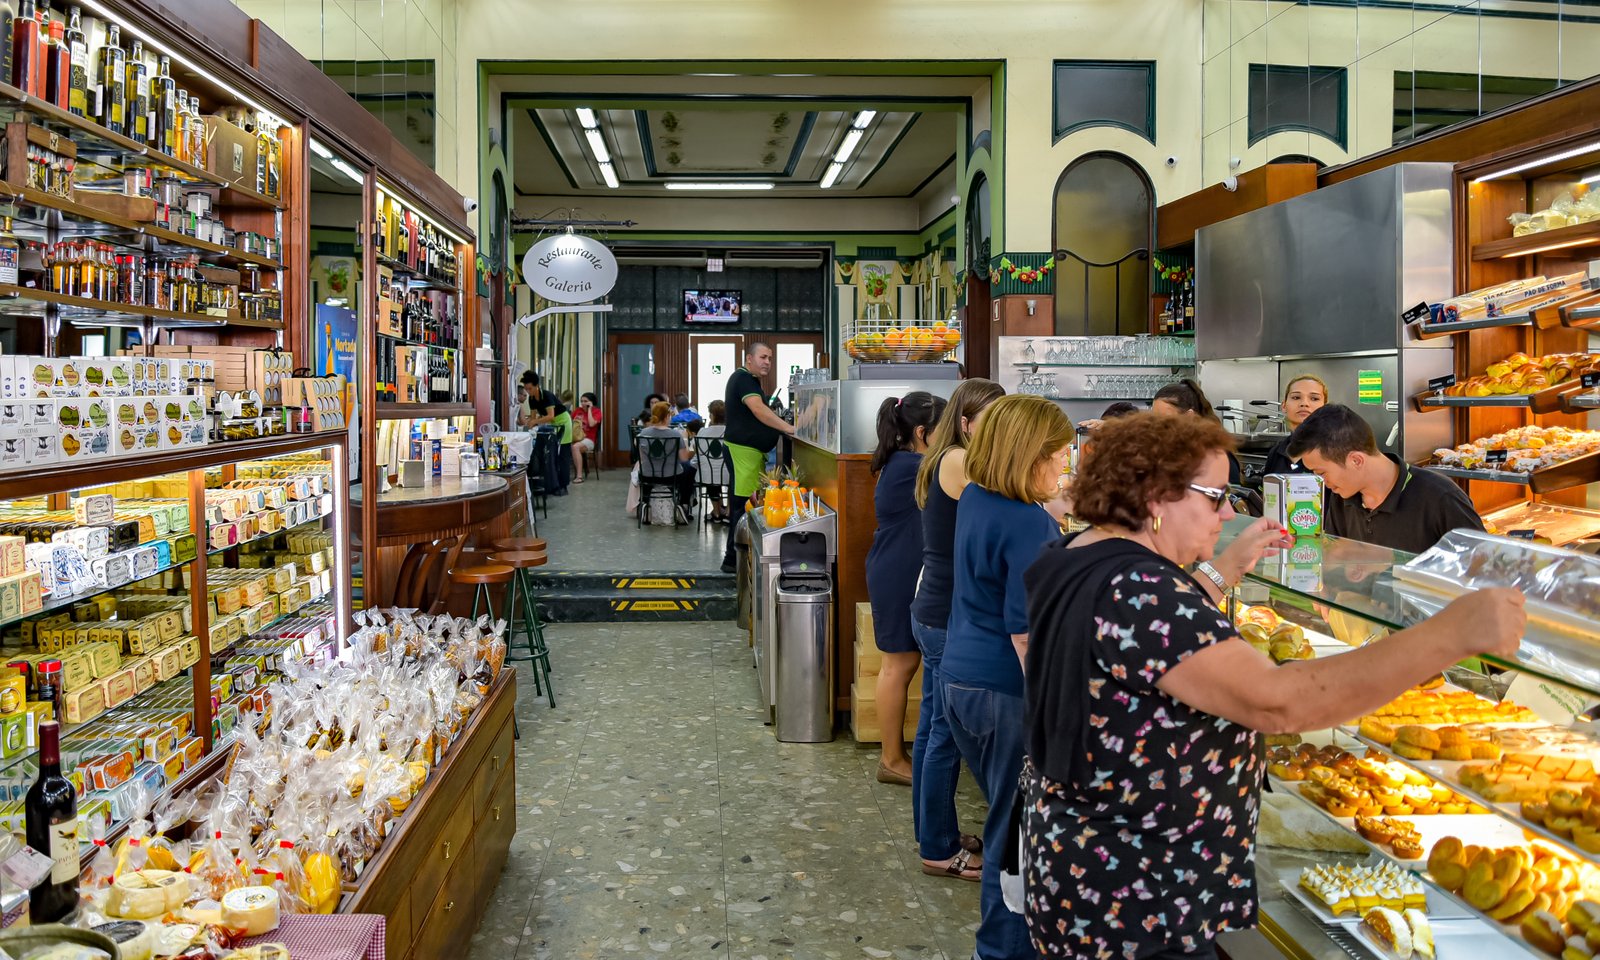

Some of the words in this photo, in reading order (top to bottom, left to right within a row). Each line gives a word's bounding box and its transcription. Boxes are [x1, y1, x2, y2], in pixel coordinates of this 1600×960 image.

[537, 246, 603, 271] Restaurante
[545, 276, 592, 293] Galeria
[1524, 288, 1537, 298] PÃO
[1537, 285, 1546, 294] DE
[1546, 280, 1566, 291] FORMA
